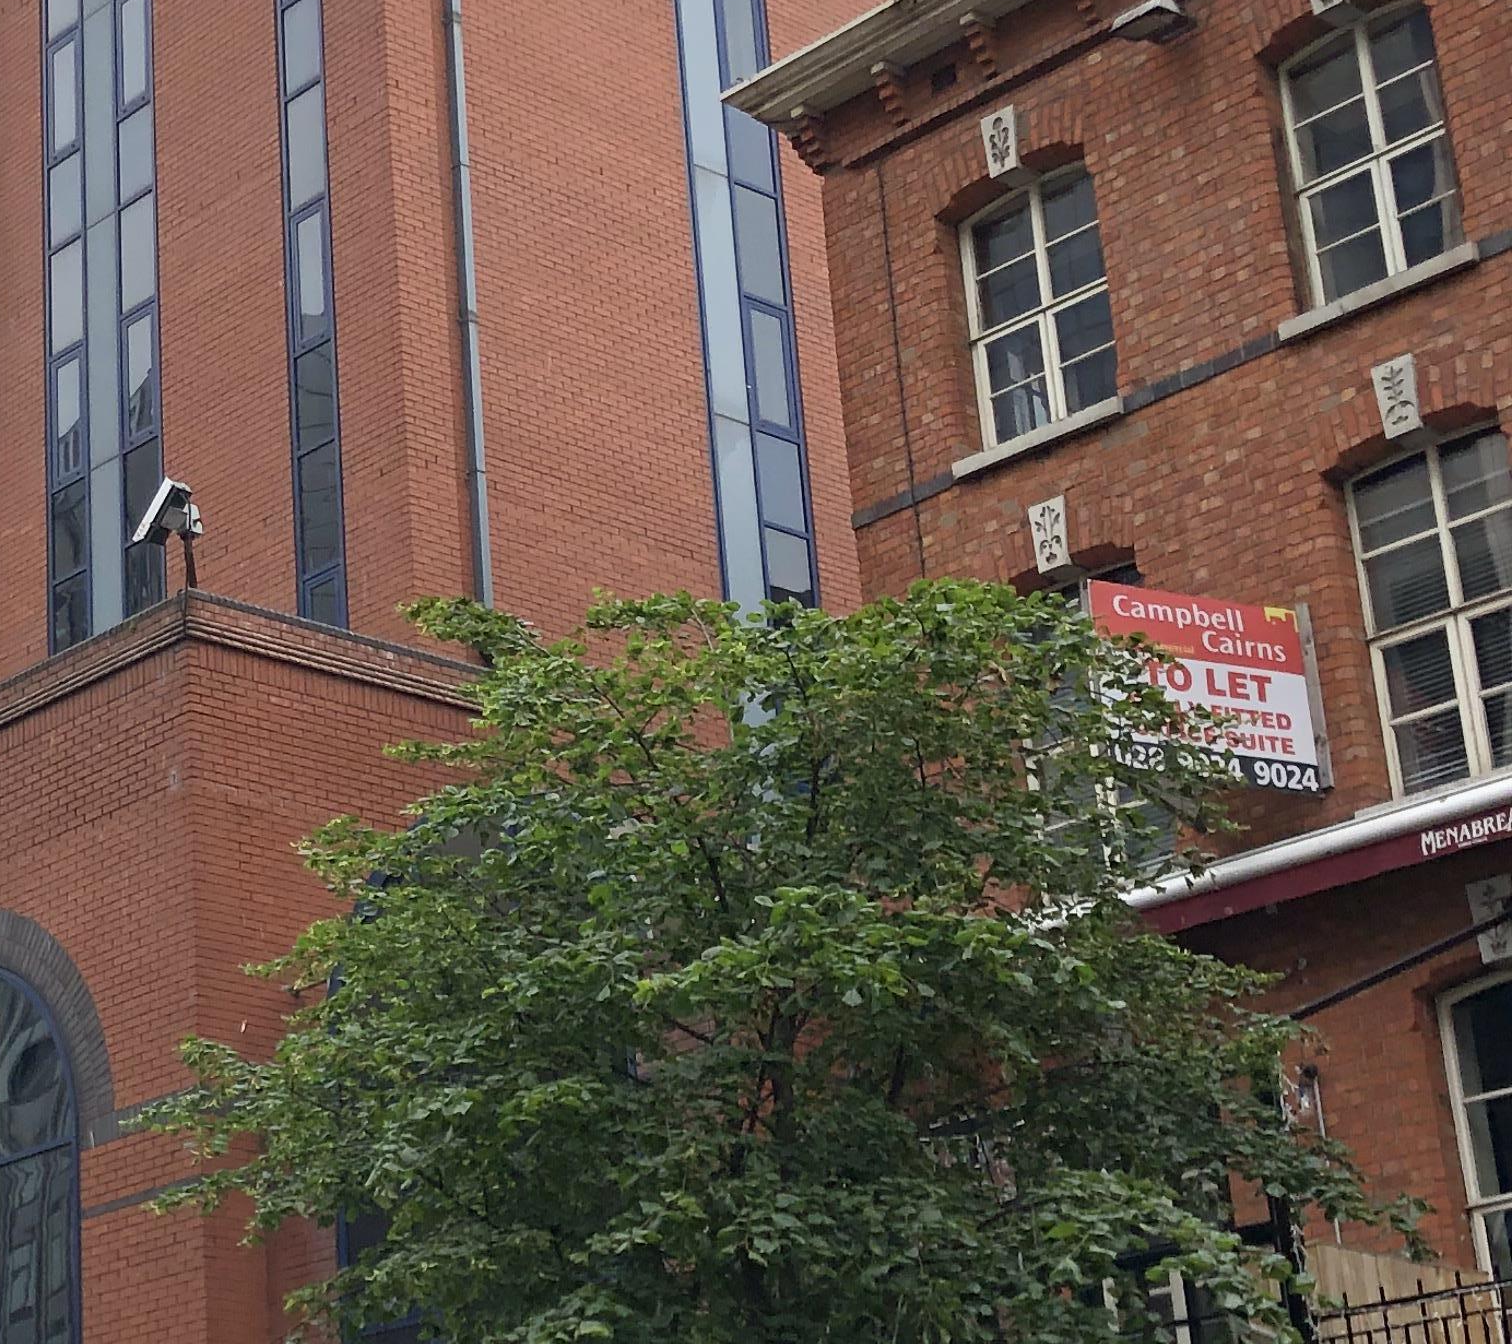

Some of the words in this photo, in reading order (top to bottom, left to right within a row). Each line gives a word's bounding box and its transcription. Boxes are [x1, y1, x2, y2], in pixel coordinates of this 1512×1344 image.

[1112, 594, 1245, 632] Campbell
[1201, 630, 1287, 662] Cairns
[1146, 660, 1192, 692] TO
[1205, 668, 1272, 703] LET
[1225, 729, 1297, 756] SUITE
[1254, 760, 1320, 792] 9024
